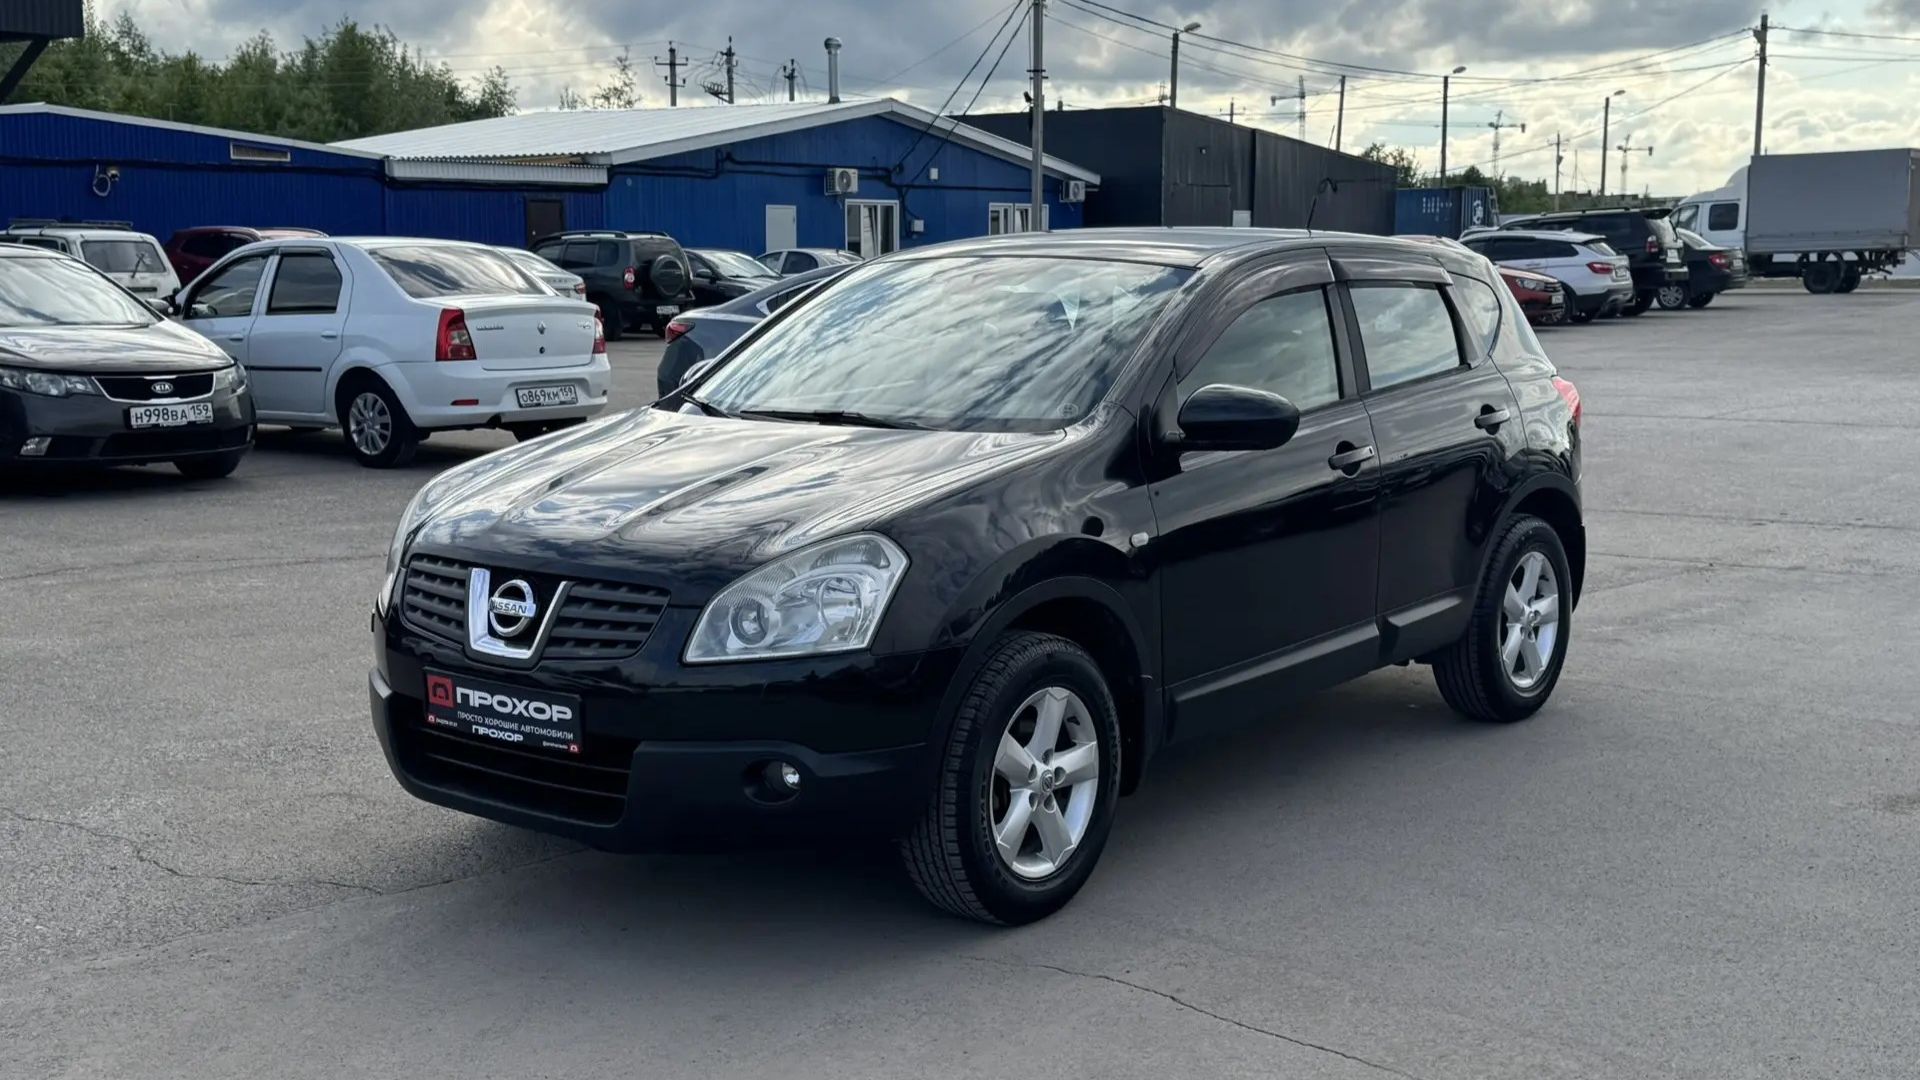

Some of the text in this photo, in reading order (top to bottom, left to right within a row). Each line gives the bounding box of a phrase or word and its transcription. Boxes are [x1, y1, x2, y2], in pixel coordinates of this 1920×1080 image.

[521, 389, 559, 402] О869КМ
[135, 404, 209, 423] Н998ВА 159
[490, 600, 527, 614] NISSAN
[456, 686, 572, 722] ПРОХОР
[457, 711, 483, 723] ПРОСТО
[484, 717, 519, 731] ХОРОШИЕ
[521, 725, 574, 740] АВТОМОБИЛИ
[472, 725, 524, 742] ПРОХОР
